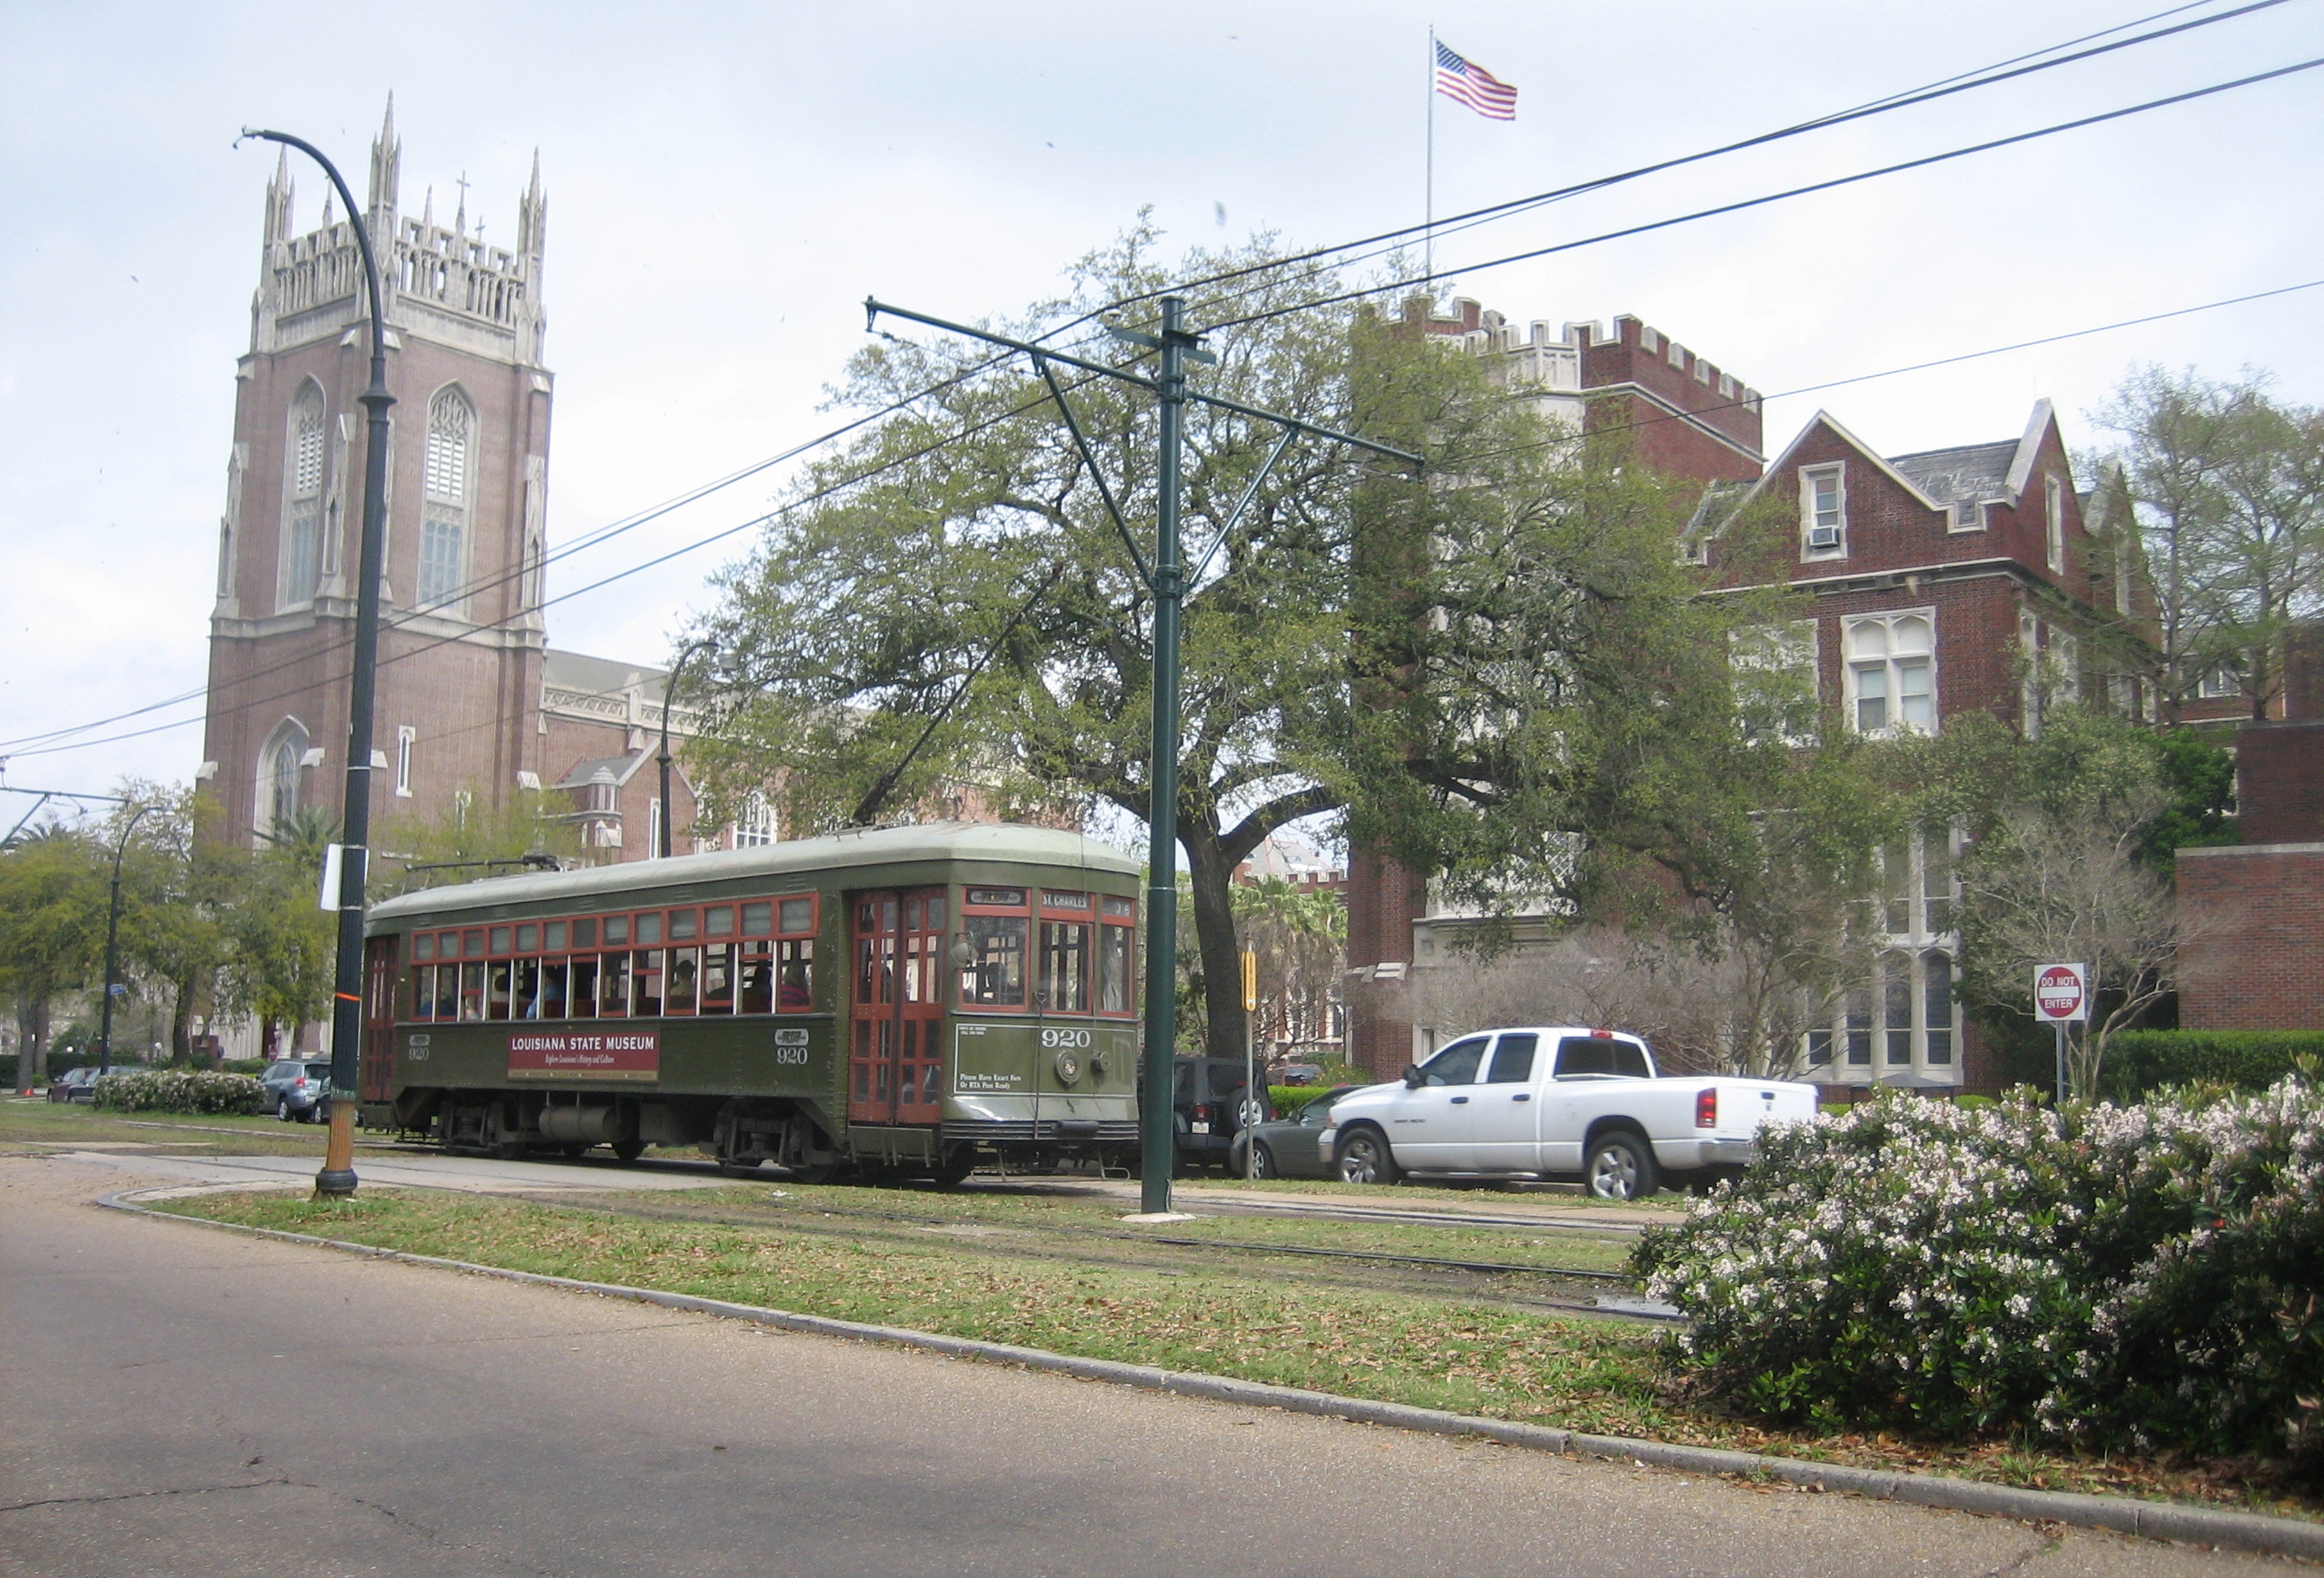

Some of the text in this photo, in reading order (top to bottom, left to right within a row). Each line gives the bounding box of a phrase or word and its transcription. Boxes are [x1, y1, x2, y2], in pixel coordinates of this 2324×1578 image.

[1042, 893, 1087, 908] ST. CHARLES
[2041, 975, 2076, 987] DO NOT
[2044, 998, 2073, 1009] ENTER
[512, 1036, 655, 1051] LOUISIANA STATE MUSEUM
[1041, 1029, 1091, 1048] 920
[776, 1047, 808, 1065] 920
[959, 1073, 977, 1081] Please
[993, 1073, 1010, 1081] Exact
